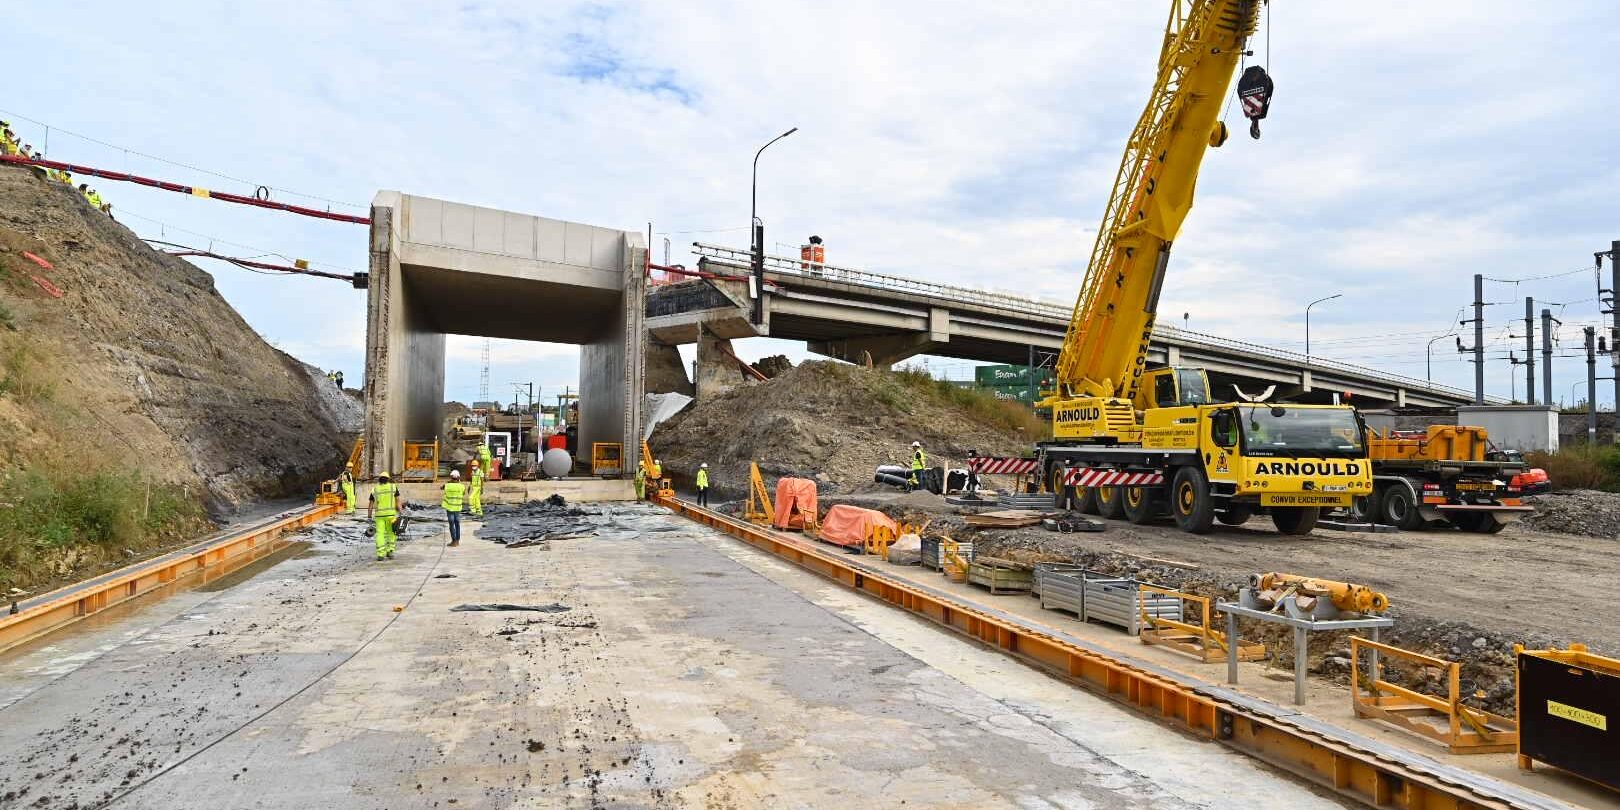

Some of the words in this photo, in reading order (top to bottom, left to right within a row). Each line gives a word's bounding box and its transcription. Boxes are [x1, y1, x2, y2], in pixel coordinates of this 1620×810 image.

[1128, 320, 1153, 399] ARNOULD
[1056, 408, 1099, 423] ARNOULD
[1255, 462, 1360, 476] ARNOULD
[1271, 495, 1296, 503] CONVOI
[1298, 495, 1342, 504] EXCEPTIONNEL
